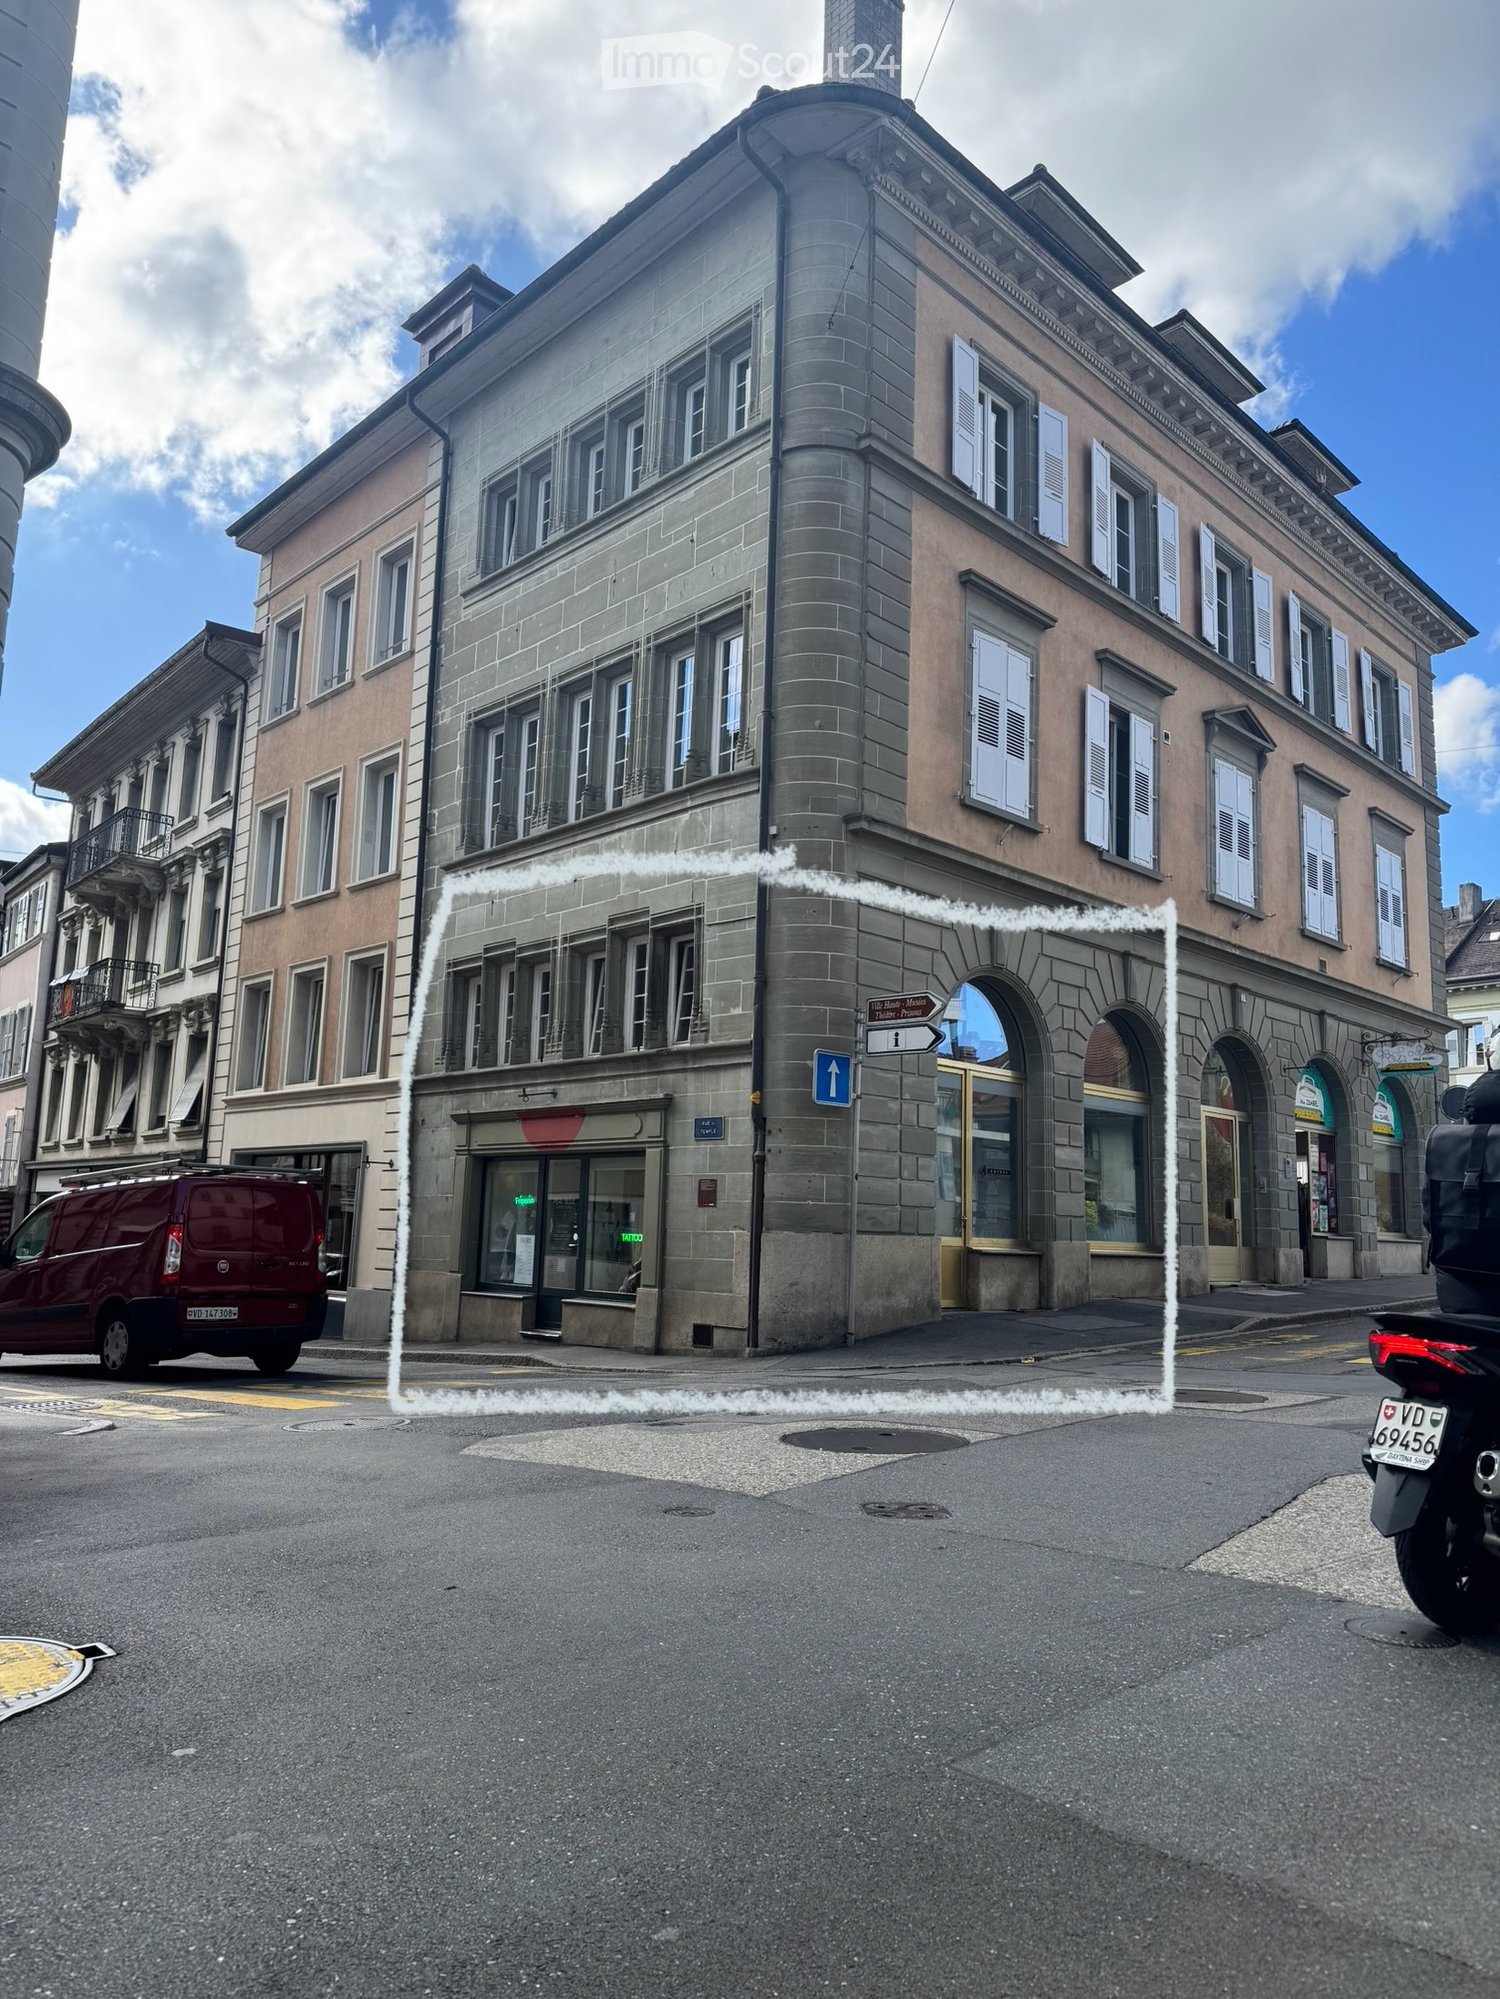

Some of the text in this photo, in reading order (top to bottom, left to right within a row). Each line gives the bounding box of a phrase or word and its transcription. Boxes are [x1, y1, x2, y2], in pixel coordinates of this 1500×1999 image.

[884, 1000, 900, 1010] Haute
[905, 997, 927, 1007] Musées
[875, 1010, 896, 1020] Théâtre
[900, 1008, 922, 1018] Prisons
[620, 1233, 643, 1242] TATTOO
[1401, 1404, 1425, 1427] VD
[1375, 1426, 1436, 1456] 69456
[1387, 1452, 1413, 1464] DAYTONA
[1413, 1456, 1431, 1466] SHOP
